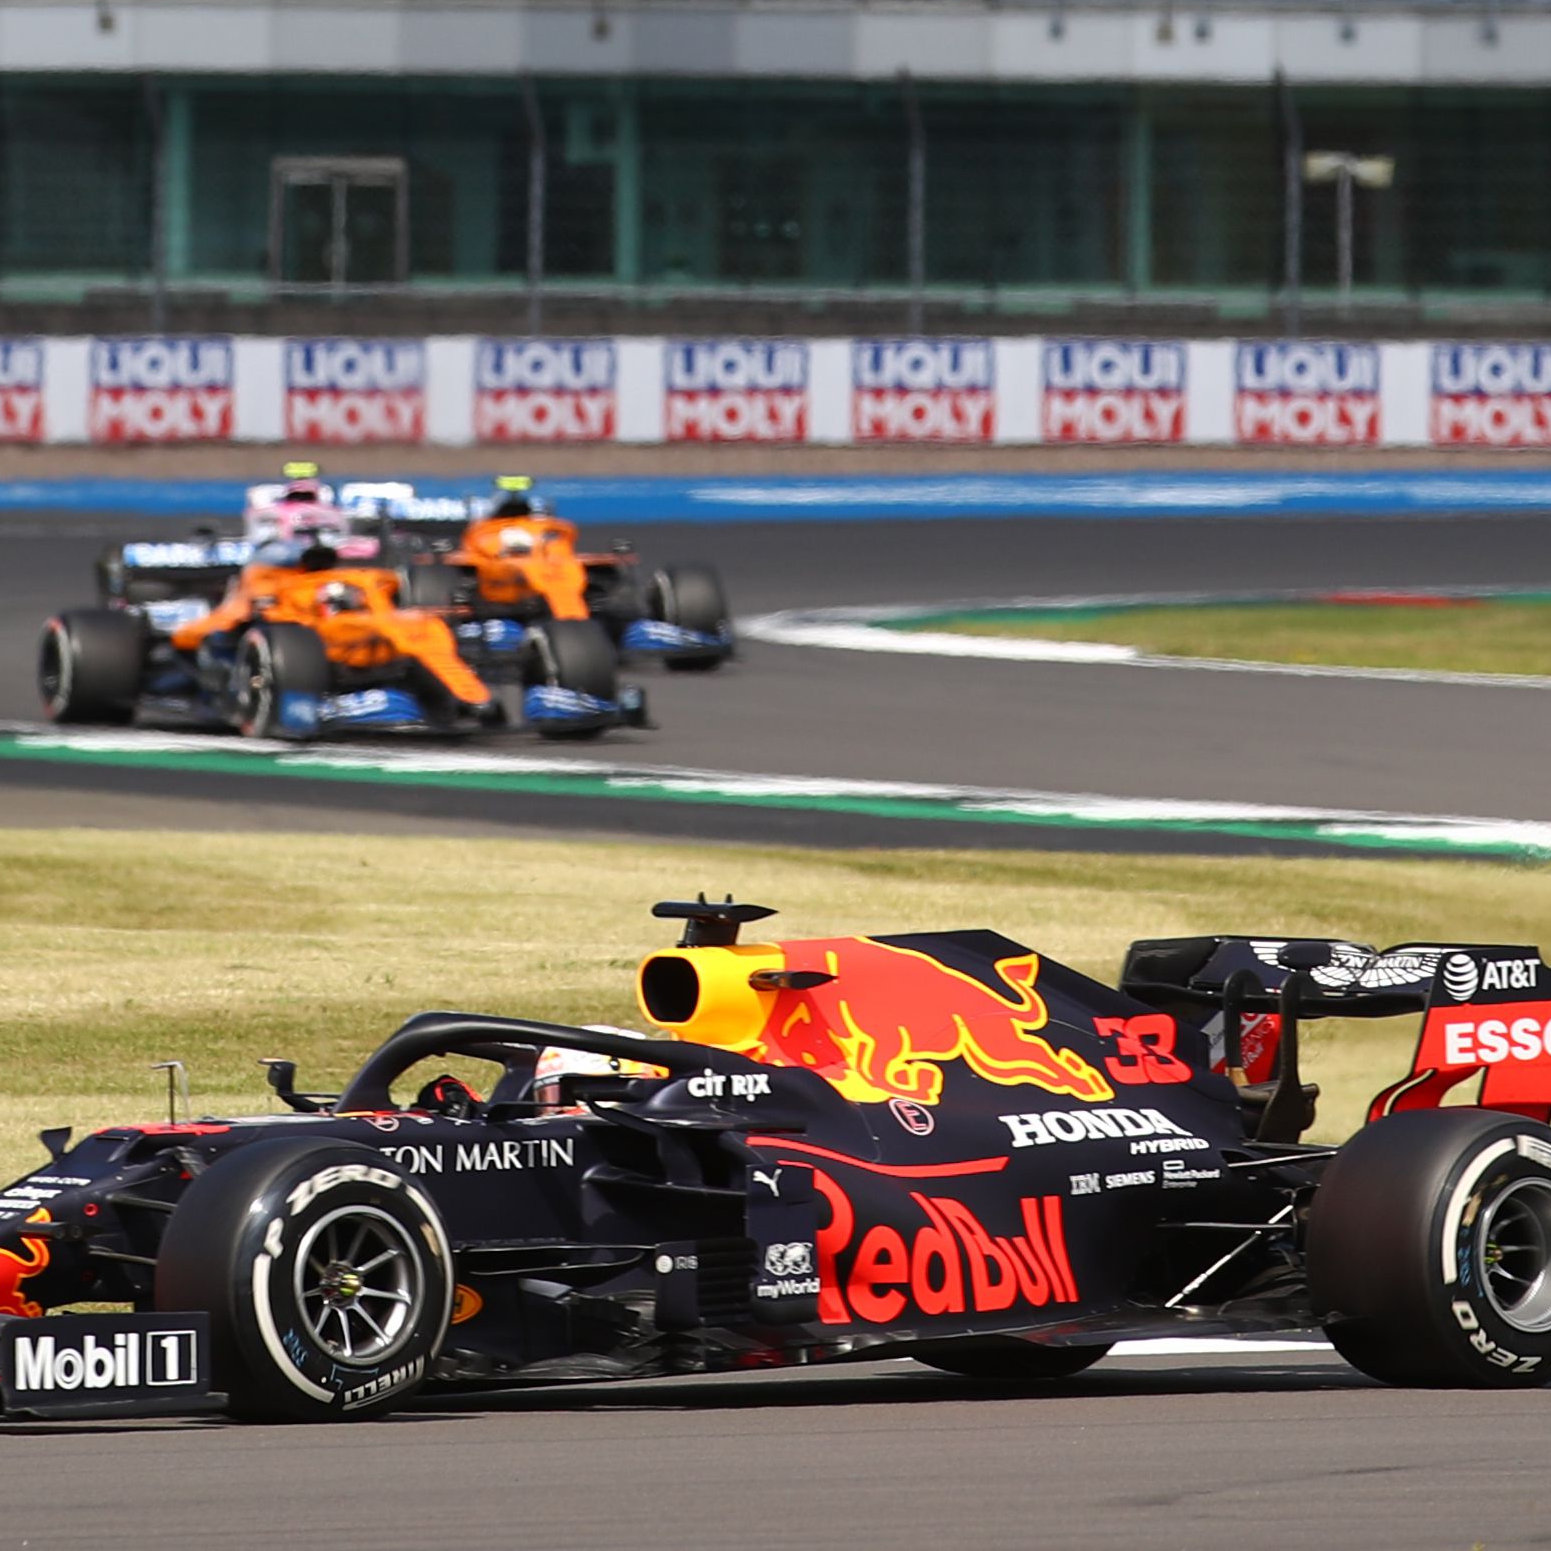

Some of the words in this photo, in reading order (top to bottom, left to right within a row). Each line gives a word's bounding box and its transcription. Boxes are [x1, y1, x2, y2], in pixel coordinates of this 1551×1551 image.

[100, 391, 234, 437] MOLY
[293, 393, 425, 438] MOLY
[486, 394, 616, 438] MOLY
[674, 393, 808, 439] MOLY
[860, 393, 995, 439] MOLY
[1051, 393, 1185, 439] MOLY
[1243, 397, 1381, 444] MOLY
[1481, 958, 1541, 990] AT&T
[1091, 1014, 1192, 1084] 33
[999, 1108, 1194, 1148] HONDA
[1129, 1138, 1210, 1155] HYBRID
[455, 1137, 574, 1171] MARTIN
[286, 1164, 402, 1217] ZERO
[1069, 1173, 1101, 1195] IBM
[1105, 1171, 1156, 1189] SIEMENS
[1452, 1301, 1542, 1373] ZERO
[14, 1333, 139, 1390] Mobil
[159, 1335, 181, 1382] 1
